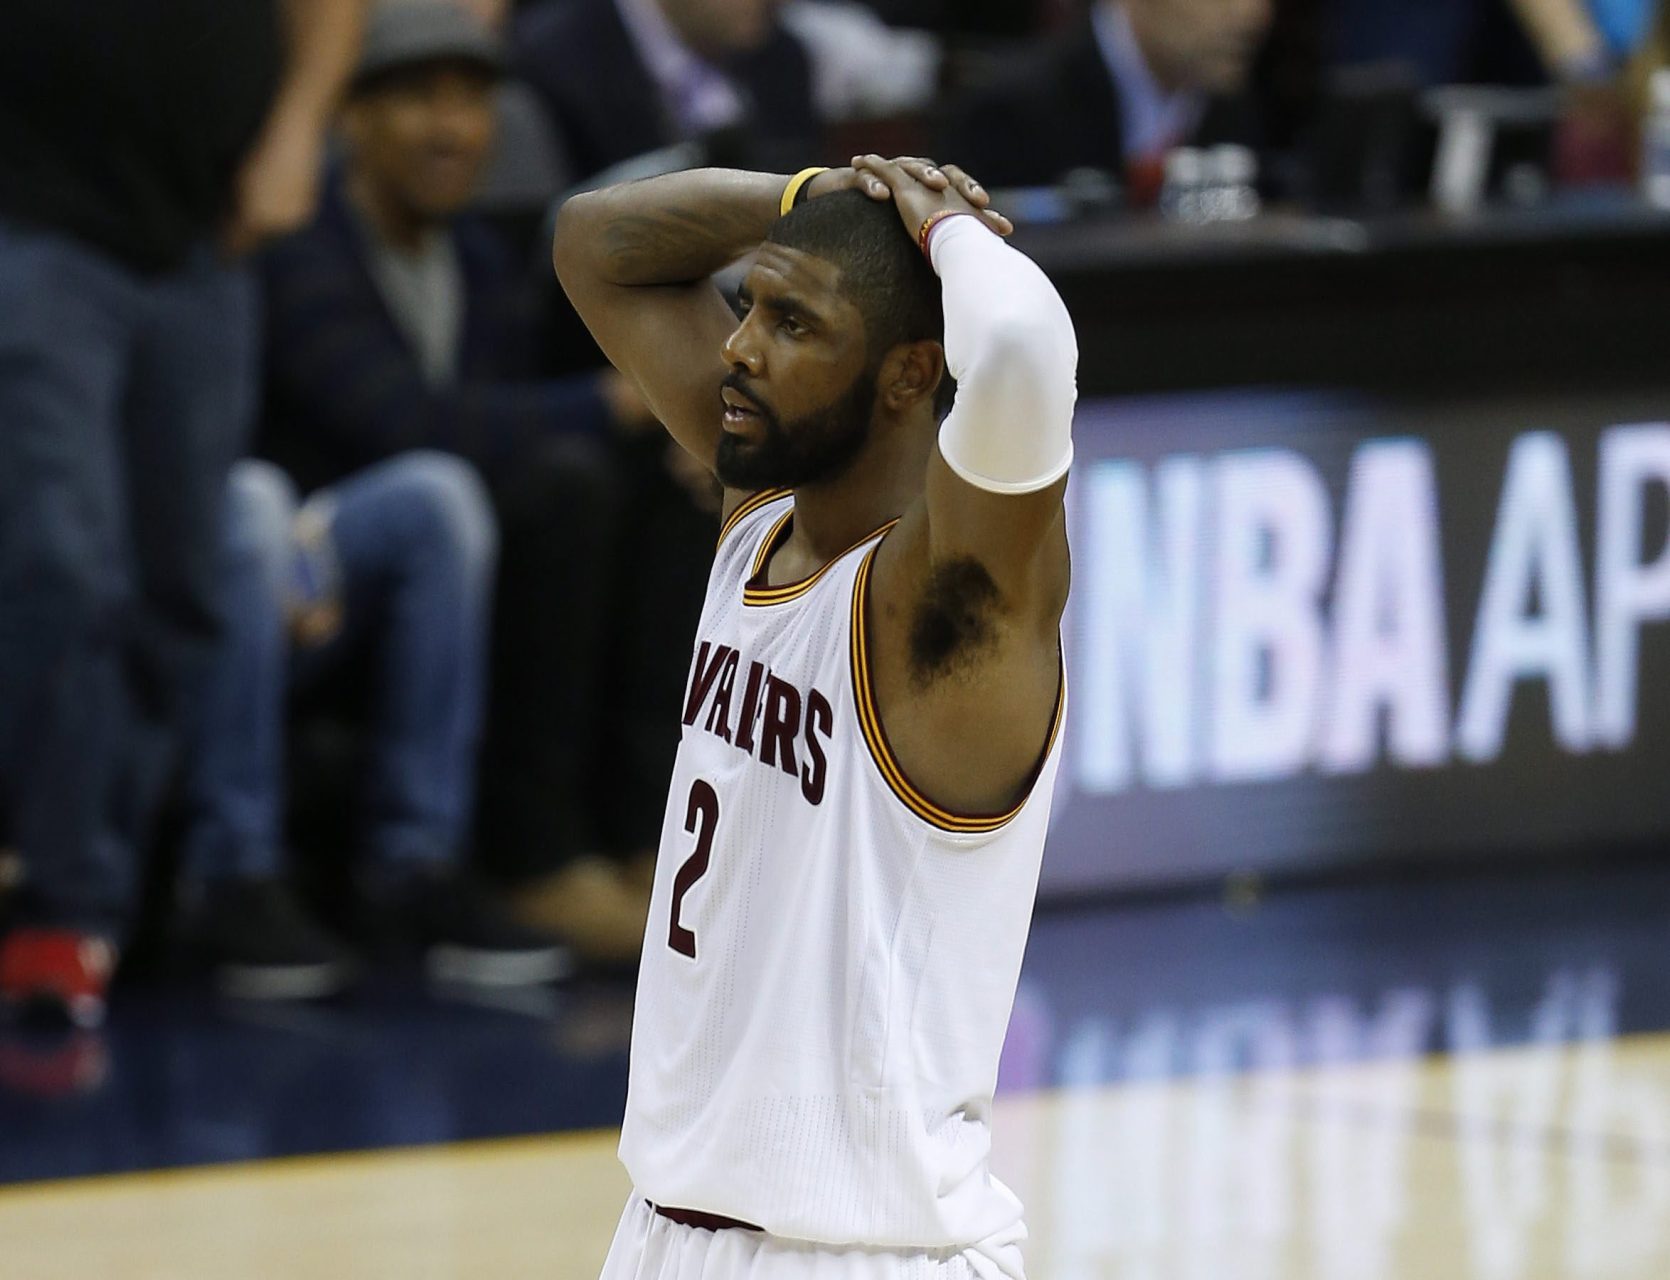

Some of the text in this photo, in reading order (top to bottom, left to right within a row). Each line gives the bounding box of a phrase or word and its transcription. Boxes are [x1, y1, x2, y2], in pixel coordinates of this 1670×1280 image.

[1079, 423, 1670, 795] NBA AP
[668, 778, 719, 958] 2
